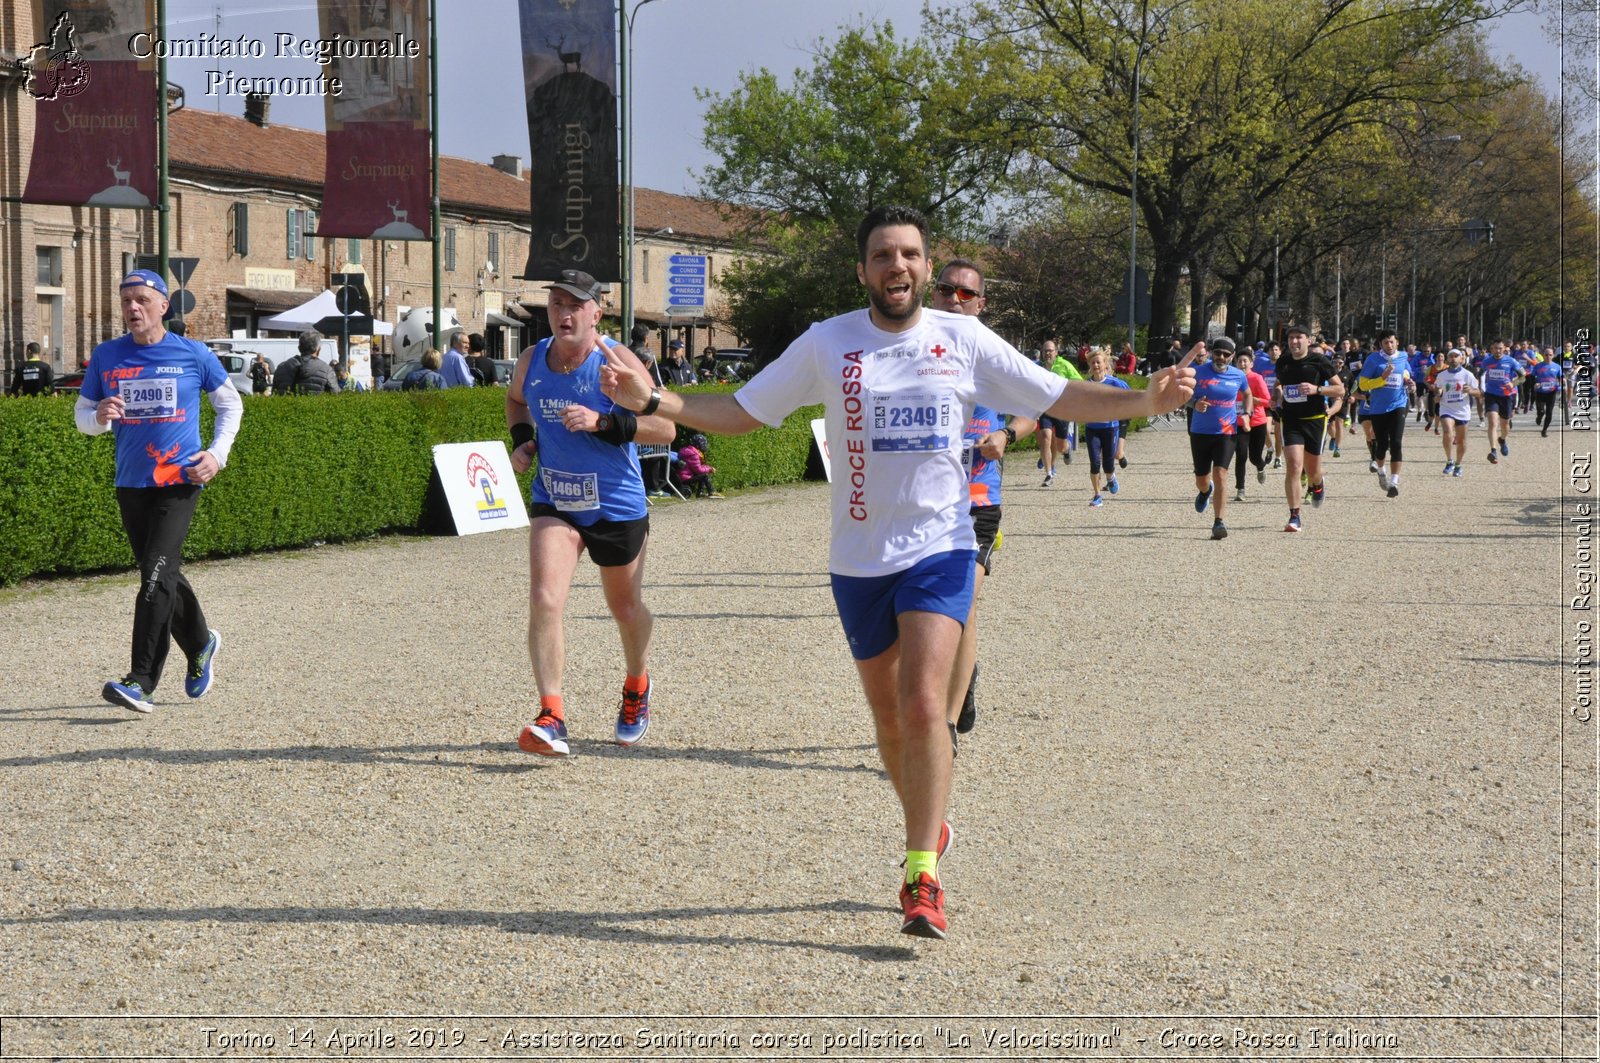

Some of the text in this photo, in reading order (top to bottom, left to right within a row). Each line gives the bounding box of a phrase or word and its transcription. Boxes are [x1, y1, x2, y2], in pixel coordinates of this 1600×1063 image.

[55, 103, 138, 135] Stupinigi
[342, 156, 415, 182] Stupinigi
[551, 121, 591, 261] Stupinigi
[917, 368, 959, 377] CASTELLAMONTE
[133, 388, 163, 402] 2490
[889, 406, 938, 427] 2349
[841, 349, 868, 522] CROCE ROSSA
[552, 480, 582, 497] 1466
